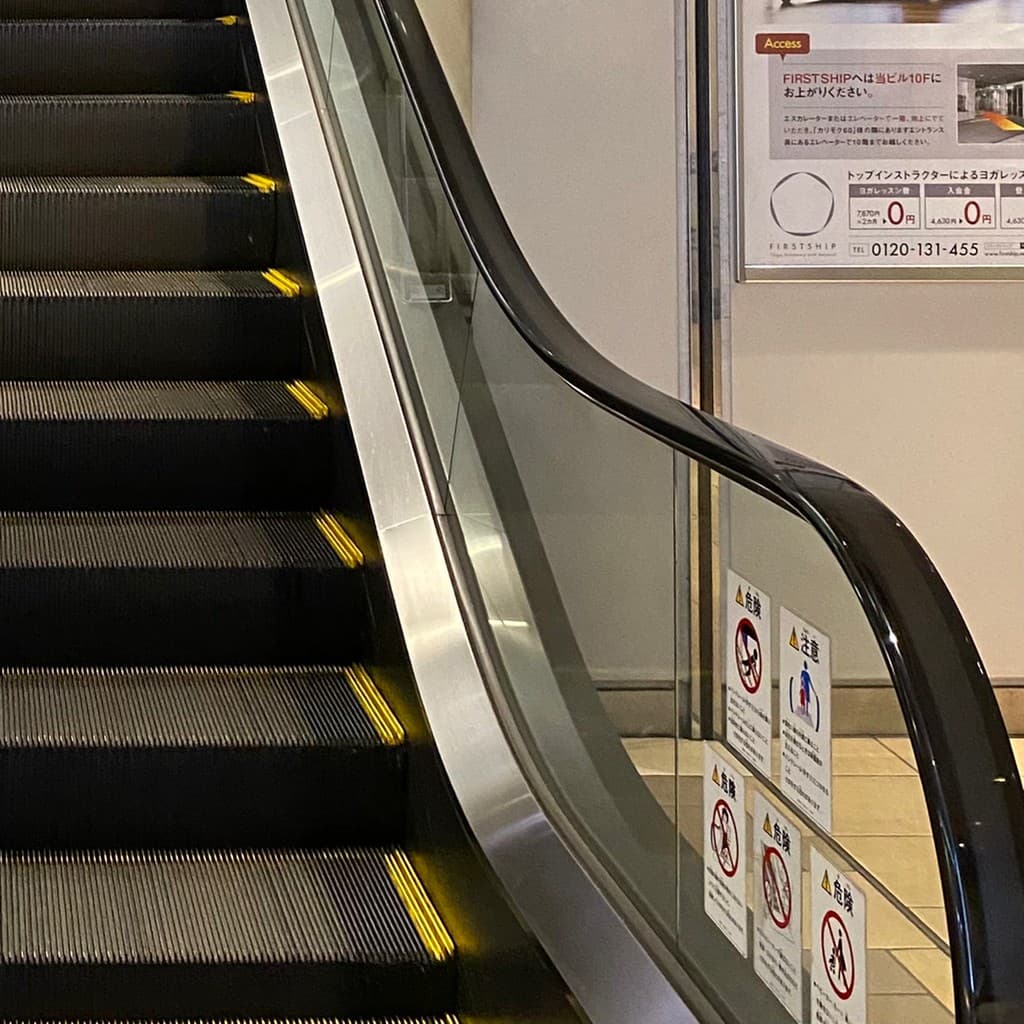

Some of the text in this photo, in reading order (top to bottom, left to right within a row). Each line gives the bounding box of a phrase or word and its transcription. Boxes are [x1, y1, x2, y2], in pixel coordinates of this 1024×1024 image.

[763, 38, 802, 49] Access
[783, 86, 873, 99] お上がりください。
[871, 242, 979, 256] 0120-131-455
[745, 591, 762, 620] 危険
[800, 632, 820, 664] 注意
[774, 822, 791, 856] 危険
[834, 879, 854, 918] 危険
